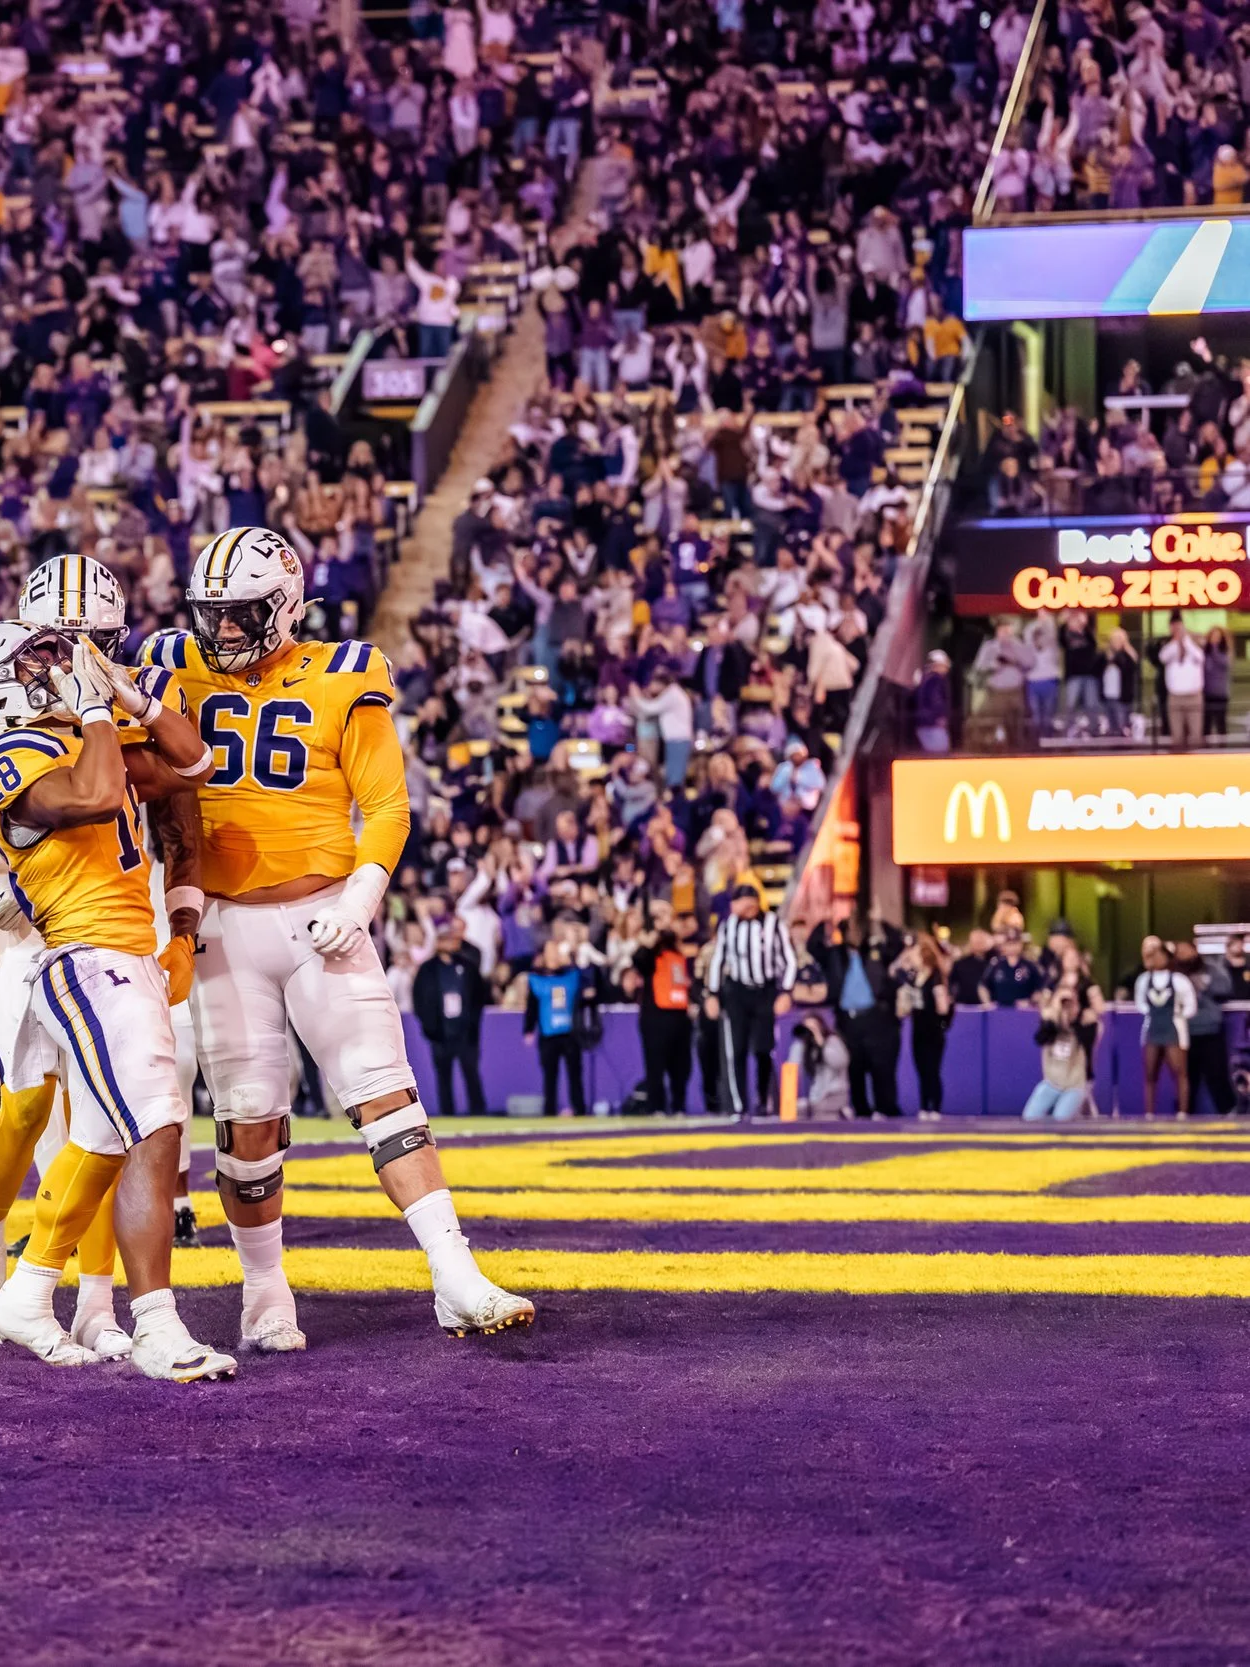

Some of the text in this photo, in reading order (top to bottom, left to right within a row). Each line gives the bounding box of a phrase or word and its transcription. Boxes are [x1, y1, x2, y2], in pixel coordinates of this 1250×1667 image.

[250, 533, 284, 559] LS
[1122, 568, 1242, 607] ZERO
[61, 619, 82, 627] LSU
[300, 657, 312, 669] 7
[199, 692, 314, 791] 66
[104, 969, 131, 987] L
